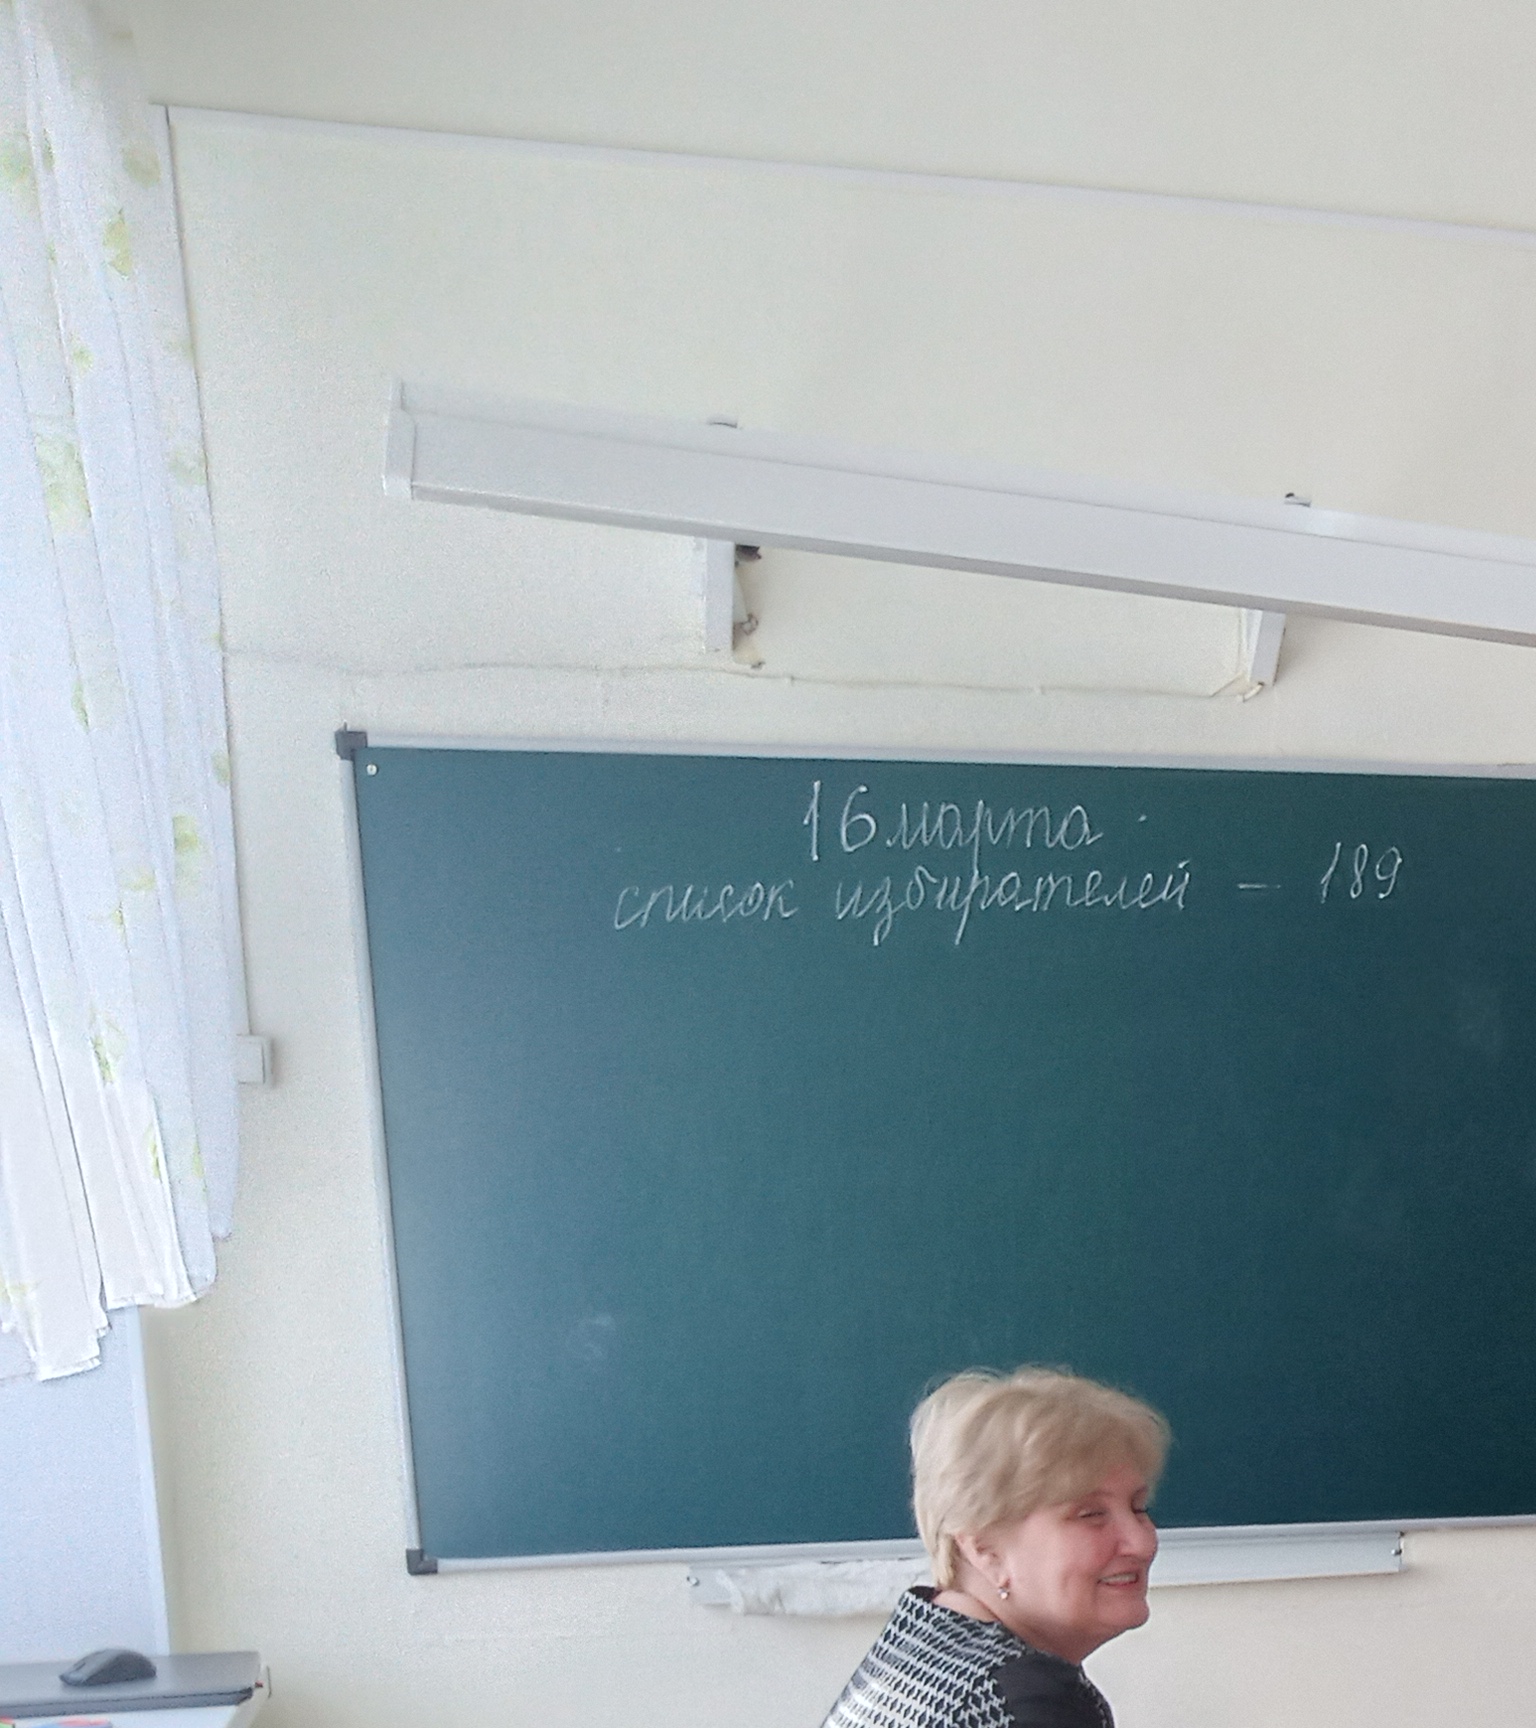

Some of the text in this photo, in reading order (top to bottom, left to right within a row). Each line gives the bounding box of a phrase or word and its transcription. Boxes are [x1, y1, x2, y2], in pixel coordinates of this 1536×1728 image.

[802, 779, 1104, 876] 16 марта
[613, 878, 800, 930] список
[835, 860, 1192, 946] избирателей
[1320, 841, 1403, 904] 189
